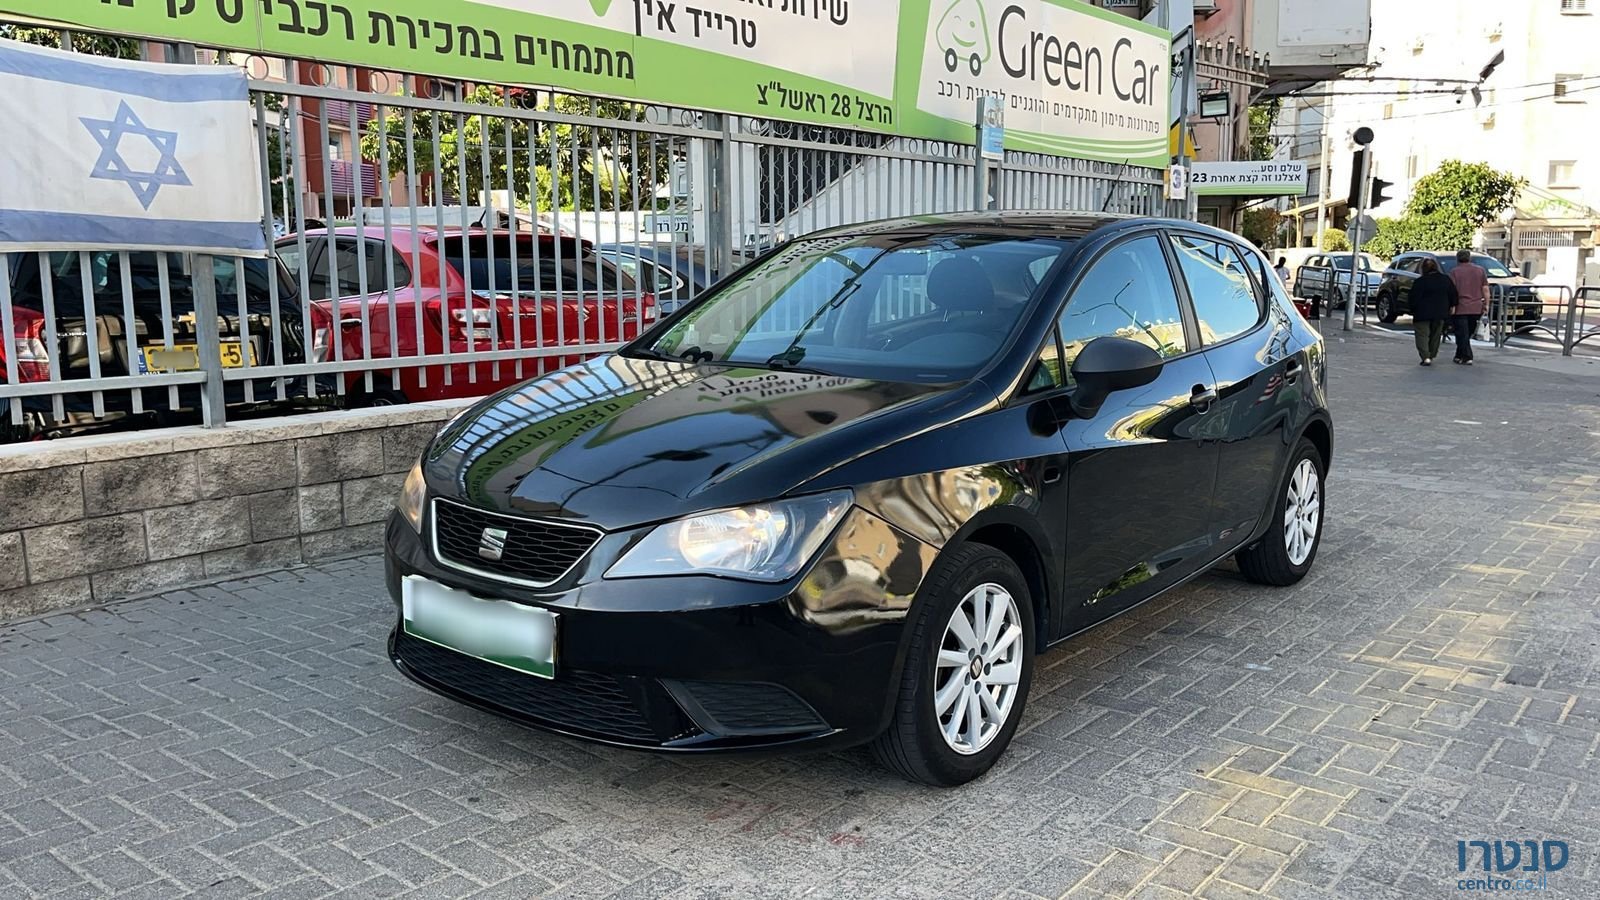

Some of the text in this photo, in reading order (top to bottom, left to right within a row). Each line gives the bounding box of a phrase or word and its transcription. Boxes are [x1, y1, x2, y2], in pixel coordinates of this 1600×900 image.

[261, 0, 354, 41] רכבי
[633, 0, 758, 48] טרייד אין
[367, 10, 504, 61] במכירת
[514, 34, 634, 80] מתמחים
[998, 4, 1159, 106] Green Car
[938, 80, 961, 99] רכב
[831, 92, 851, 118] 28
[855, 95, 893, 125] הרצל
[1011, 95, 1049, 115] והוגנים
[1054, 102, 1098, 124] מתקדמים
[1101, 111, 1124, 128] מימון
[1128, 117, 1160, 134] פתרונות
[1192, 172, 1301, 184] אצלנו זה קצת אחרת 23
[1251, 164, 1302, 173] שלם וסע...
